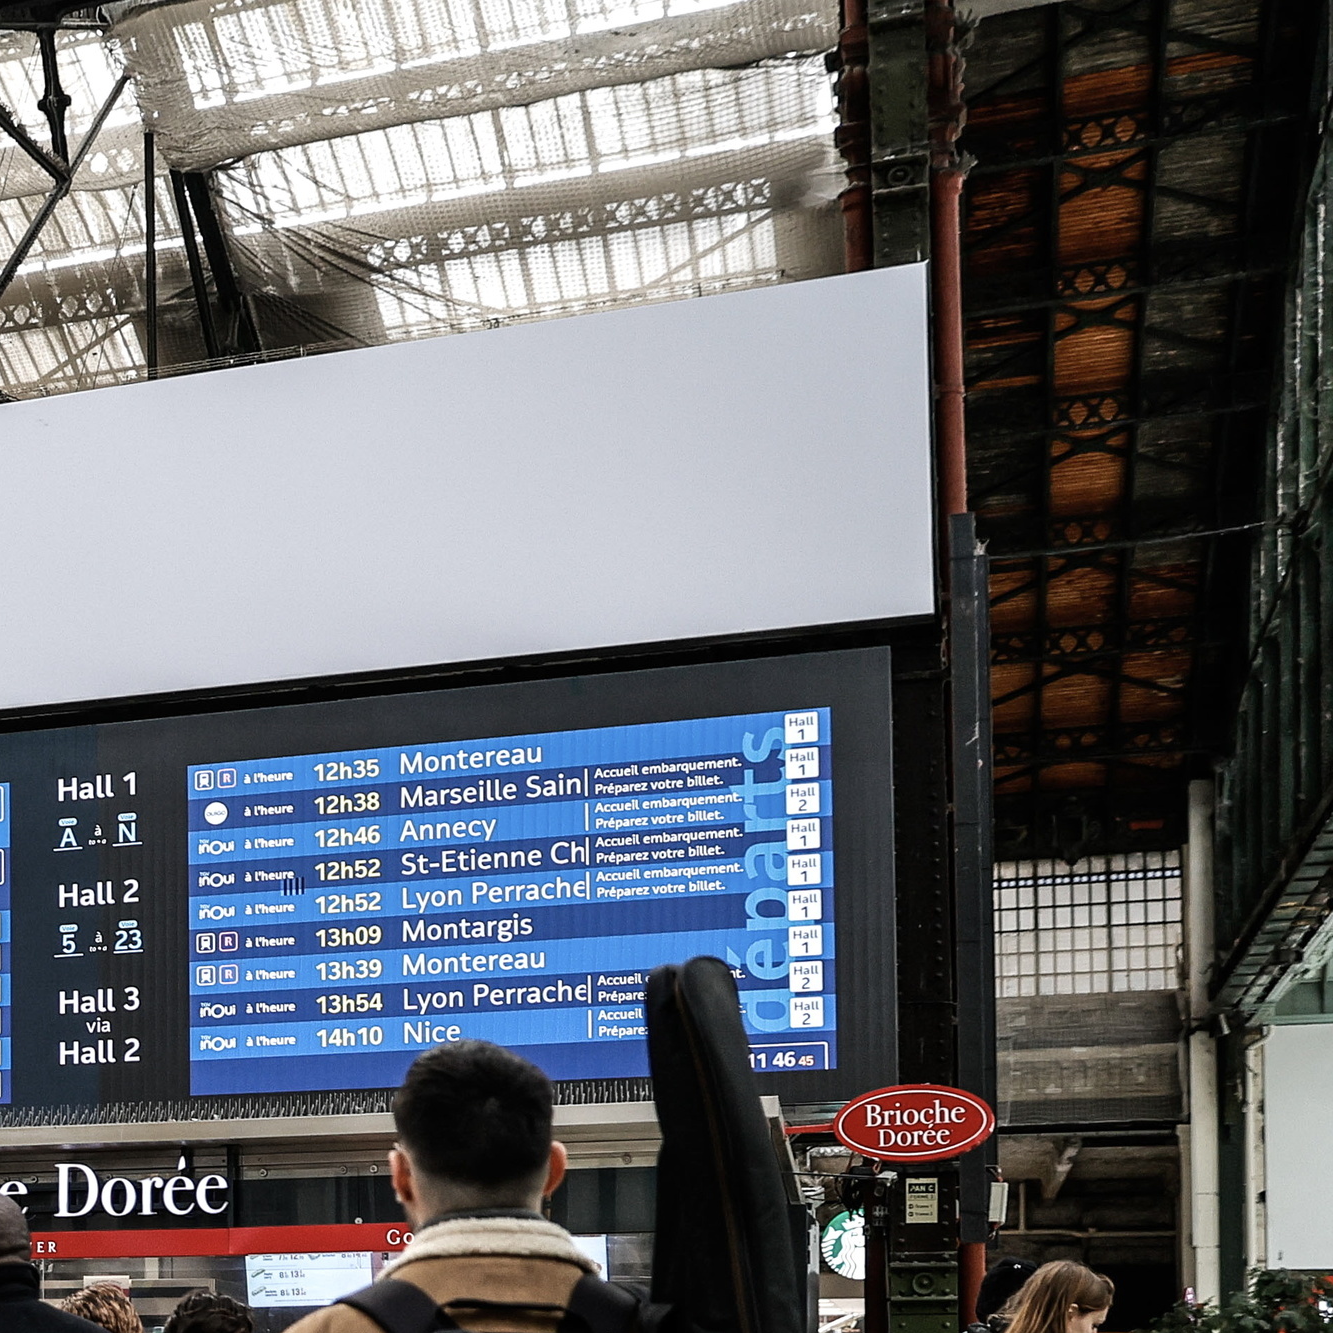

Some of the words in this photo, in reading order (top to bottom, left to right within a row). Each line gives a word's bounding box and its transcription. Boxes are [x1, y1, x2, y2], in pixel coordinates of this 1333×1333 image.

[313, 758, 380, 783] 12h35
[399, 746, 543, 775] Montereau
[57, 773, 114, 802] Hall
[122, 771, 136, 795] 1
[313, 792, 380, 815] 12h38
[399, 780, 517, 809] Marseille
[525, 774, 582, 800] Sain
[59, 827, 78, 848] A
[94, 824, 102, 836] à
[118, 822, 136, 842] N
[314, 825, 381, 848] 12h46
[399, 818, 497, 843] Annecy
[315, 858, 382, 881] 12h52
[400, 847, 543, 877] St-Etienne
[550, 840, 585, 864] Ch
[57, 881, 115, 908] Hall
[123, 878, 139, 903] 2
[315, 892, 382, 915] 12h52
[401, 885, 462, 914] Lyon
[471, 874, 586, 904] Perrache
[62, 933, 76, 954] 5
[94, 931, 103, 943] à
[114, 929, 142, 951] 23
[315, 925, 382, 948] 13h09
[401, 913, 534, 943] Montargis
[315, 959, 383, 982] 13h39
[401, 952, 546, 977] Montereau
[58, 988, 116, 1015] Hall
[123, 986, 140, 1011] 3
[316, 992, 384, 1015] 13h54
[402, 987, 464, 1015] Lyon
[472, 979, 587, 1007] Perrache
[86, 1017, 110, 1033] via
[316, 1026, 384, 1048] 14h10
[403, 1020, 462, 1045] Nice
[58, 1039, 116, 1065] Hall
[123, 1037, 140, 1062] 2
[772, 1051, 796, 1067] 46
[798, 1055, 814, 1066] 45
[865, 1100, 966, 1128] Brioche
[878, 1123, 951, 1147] Dorée
[53, 1155, 229, 1218] Dorée
